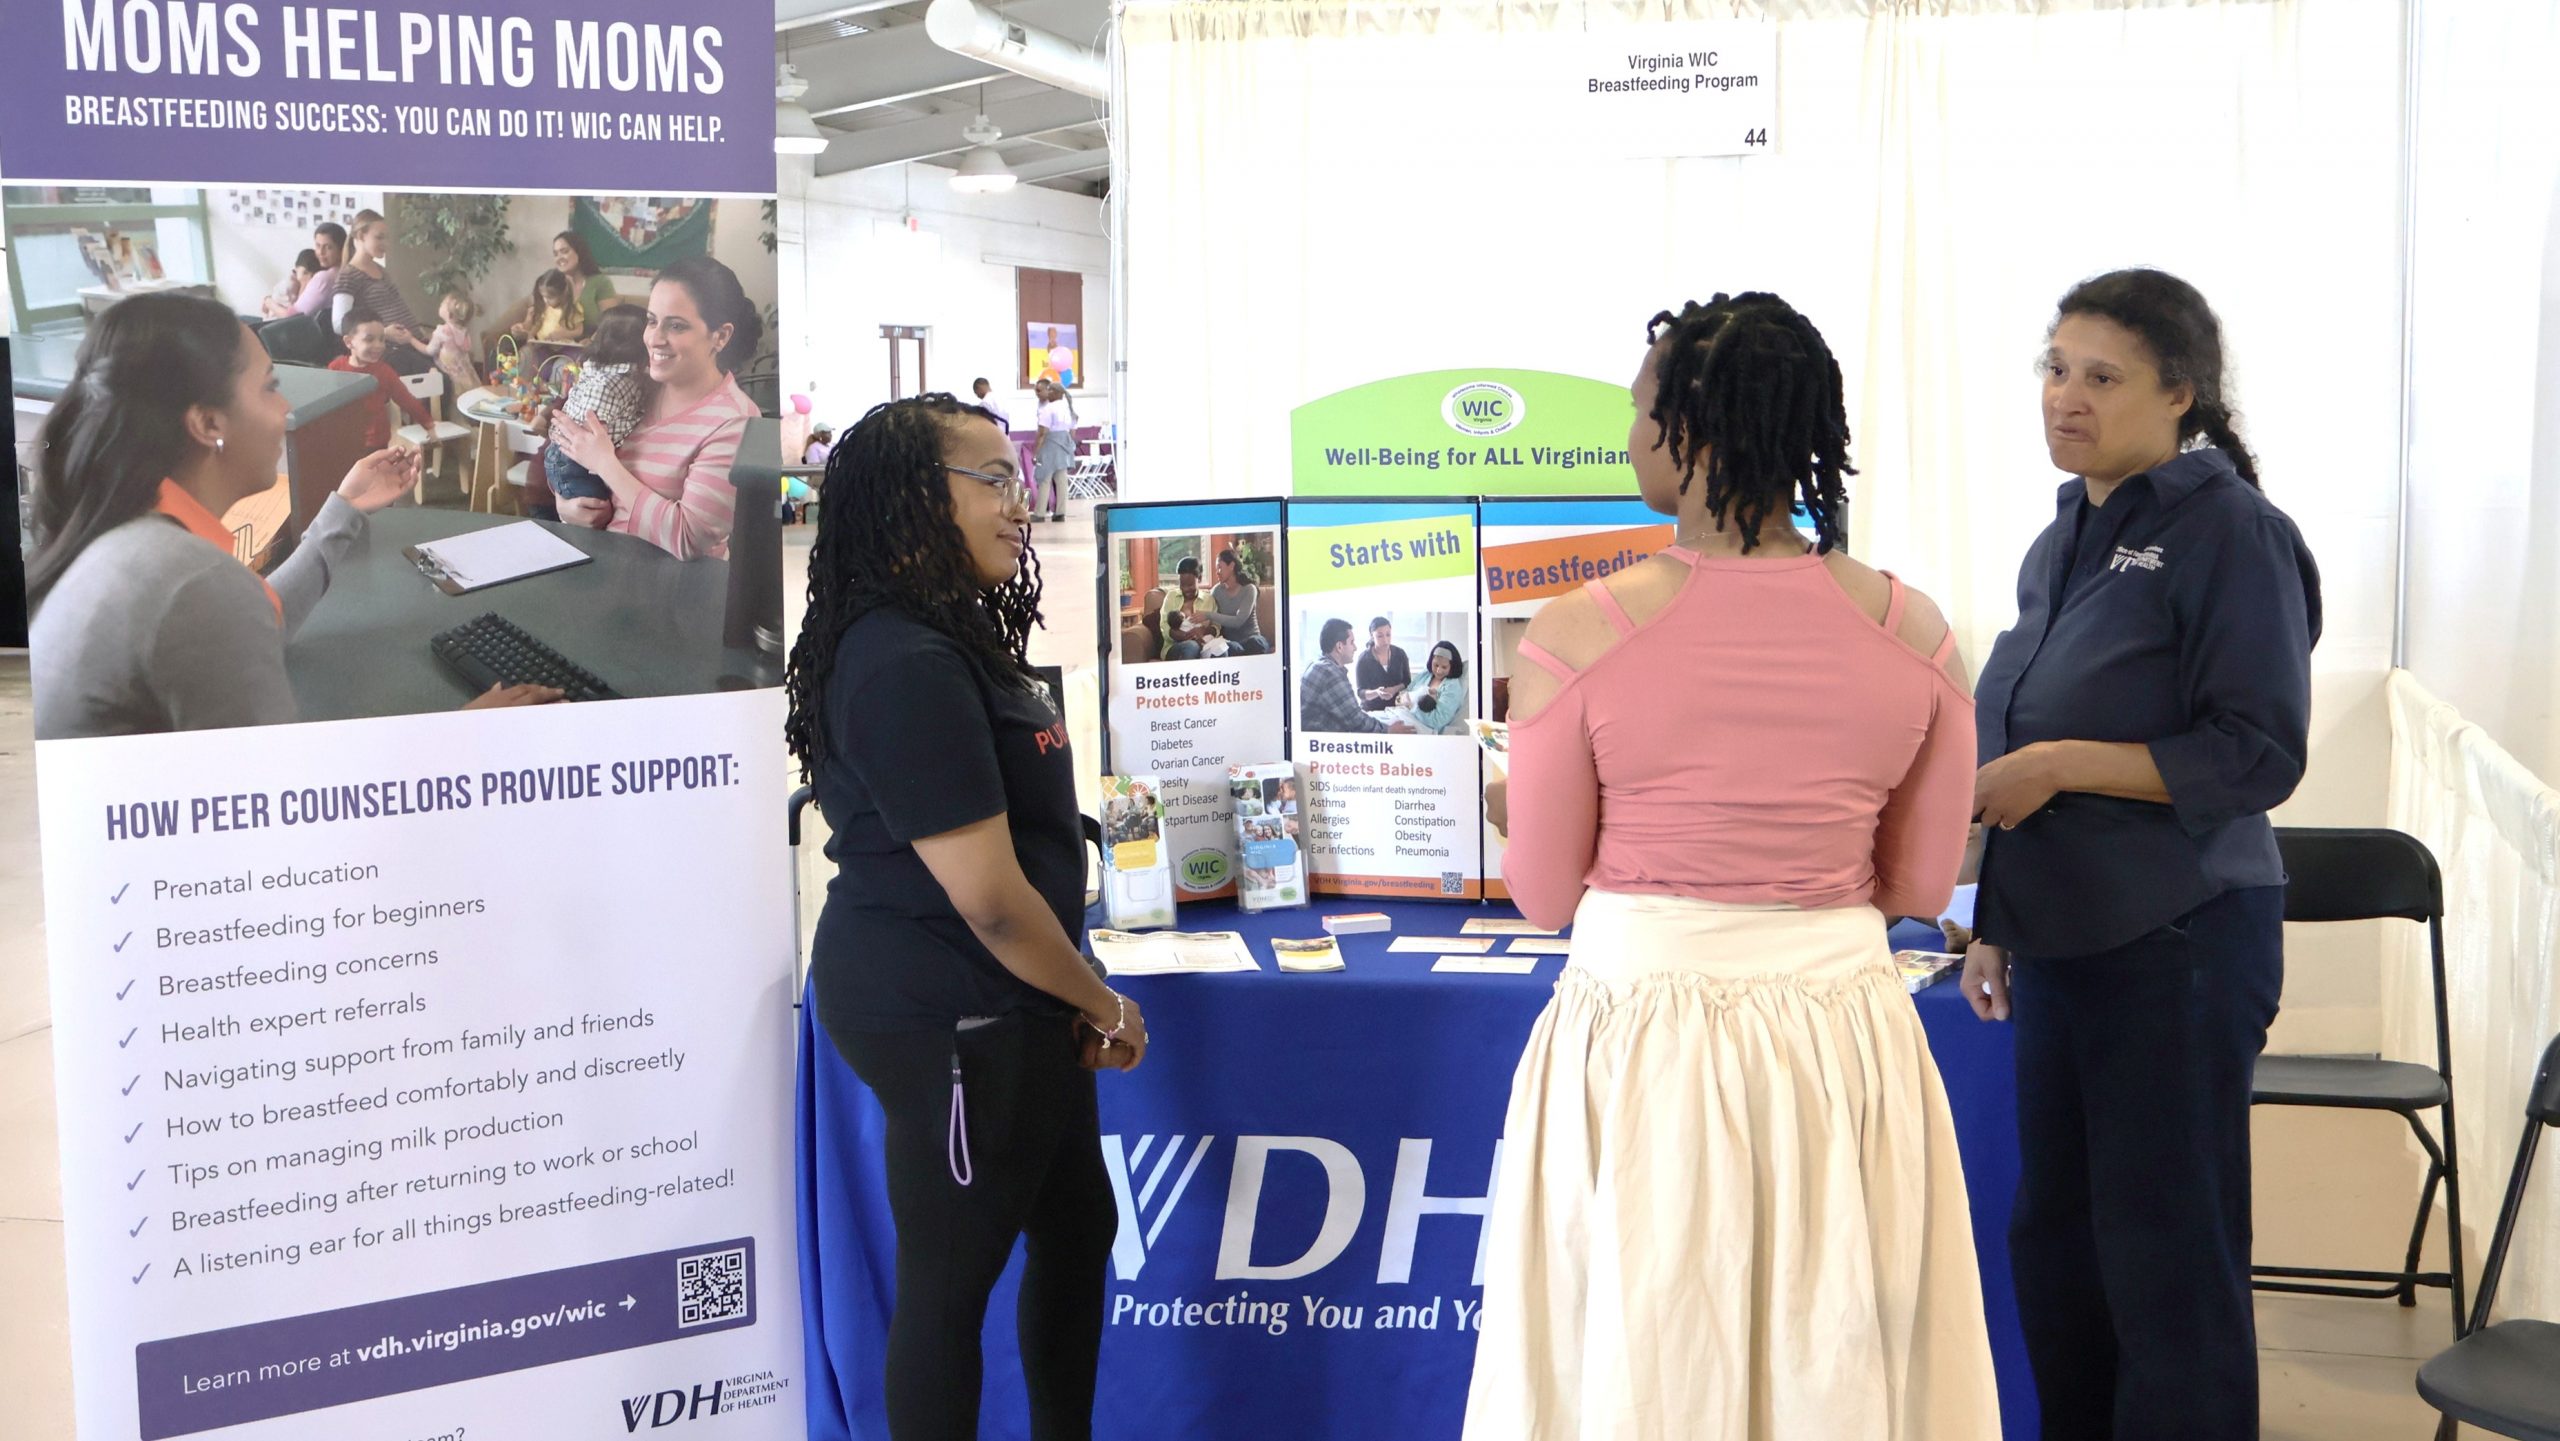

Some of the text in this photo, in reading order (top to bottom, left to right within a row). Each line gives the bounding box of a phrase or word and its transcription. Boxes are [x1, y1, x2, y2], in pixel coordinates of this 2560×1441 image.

[63, 0, 724, 94] MOMS HELPING MOMS
[1628, 51, 1718, 73] Virginia WIC
[1589, 74, 1758, 93] Breastfeeding Program
[66, 95, 725, 142] BREASTFEEDING SUCCESS: YOU CAN DO IT! WIC CAN HELP.
[1744, 128, 1767, 146] 44
[1462, 400, 1502, 416] WIC
[1325, 445, 1630, 470] Well-Being for ALL Virginian
[1331, 530, 1461, 570] Starts with
[1486, 549, 1648, 592] Breastfeedi
[1136, 671, 1240, 690] Breastfeeding
[1136, 689, 1263, 710] Protects Mothers
[1151, 718, 1217, 732] Breast Cancer
[1035, 723, 1067, 754] PU
[1151, 738, 1193, 751] Diabetes
[1310, 739, 1393, 754] Breastmilk
[1151, 756, 1225, 770] Ovarian Cancer
[1309, 761, 1433, 777] Protects Babies
[107, 753, 739, 841] HOW PEER COUNSELORS PROVIDE SUPPORT:
[1309, 781, 1446, 797] SIDS (sudden infant death syndrome)
[1183, 794, 1219, 806] Disease
[1309, 798, 1346, 808] Asthma
[1395, 800, 1436, 811] Diarrhea
[1166, 814, 1208, 828] stpartum
[1310, 813, 1350, 827] Allergies
[1395, 815, 1456, 828] Constipation
[1310, 829, 1343, 840] Cancer
[1395, 830, 1432, 843] Obesity
[1311, 844, 1375, 856] Ear infections
[1395, 845, 1449, 857] Pneumonia
[1189, 860, 1219, 875] WIC
[154, 862, 378, 900] Prenatal education
[157, 899, 485, 948] Breastfeeding for beginners
[159, 950, 438, 996] Breastfeeding concerns
[162, 992, 426, 1043] Health expert referrals
[165, 1008, 654, 1091] Navigating support from family and friends
[167, 1048, 685, 1138] How to breastfeed comfortably and discreetly
[168, 1112, 563, 1189] Tips on managing milk production
[172, 1130, 697, 1231] Breastfeeding after returning to work or school
[1100, 1133, 1506, 1287] VDH
[173, 1168, 734, 1278] A listening ear for all things breastfeeding-related!
[1112, 1291, 1290, 1335] Protecting
[1303, 1296, 1363, 1329] You
[1375, 1296, 1441, 1330] and
[184, 1300, 606, 1394] Learn more at vdh.virginia.gov/wic
[724, 1378, 790, 1400] DEPARTMENT
[725, 1371, 773, 1387] VIRGINIA
[621, 1380, 723, 1433] VDH
[721, 1394, 776, 1413] OF HEALTH
